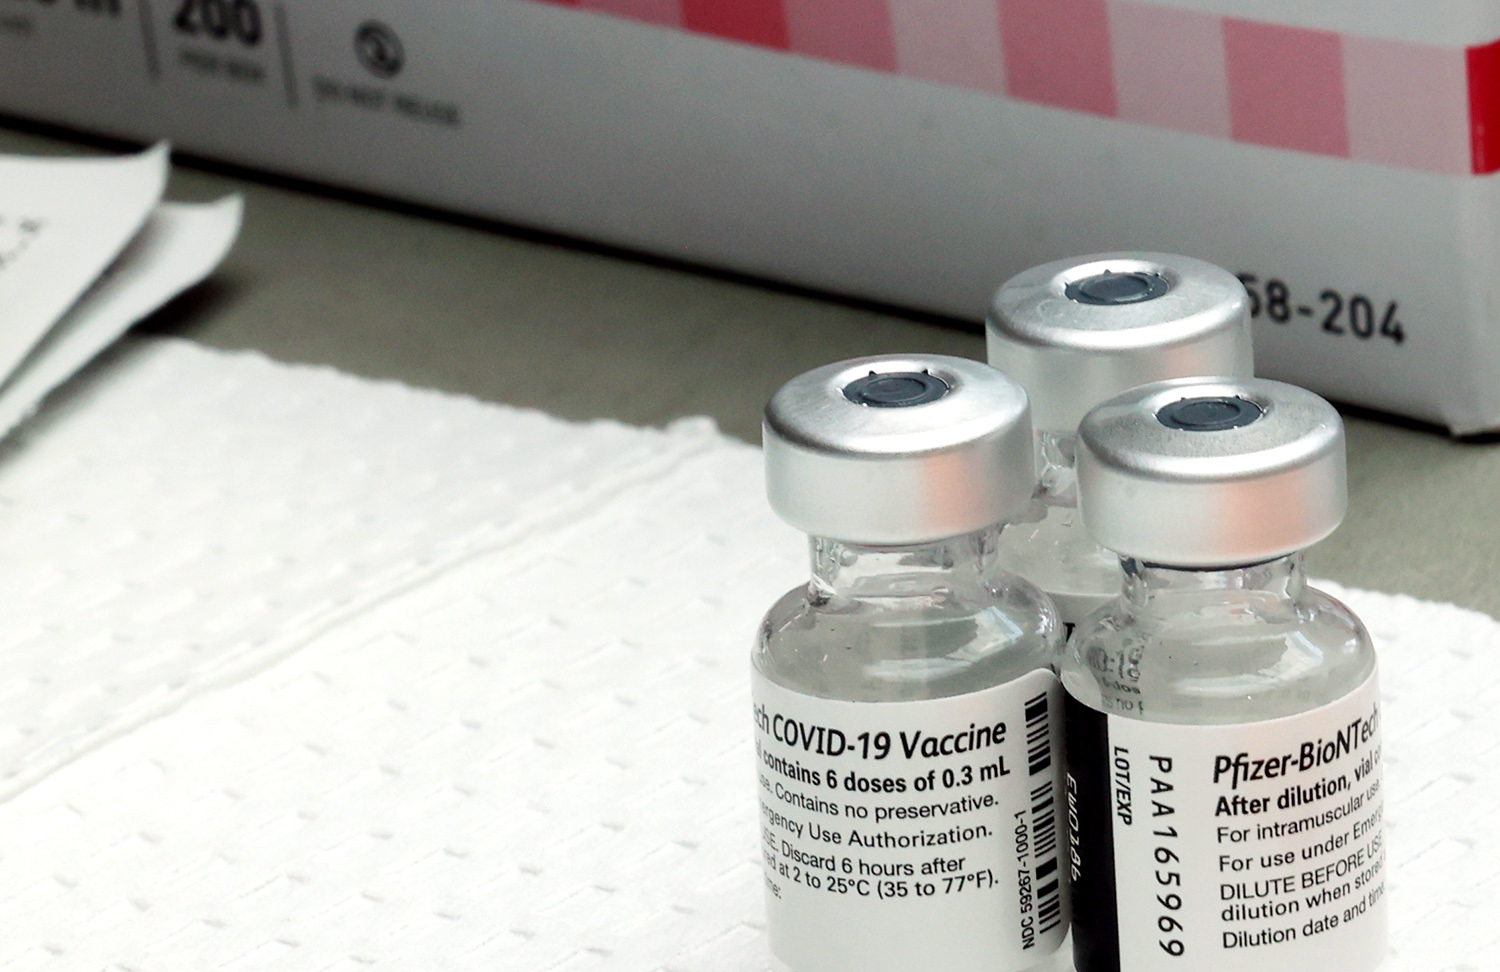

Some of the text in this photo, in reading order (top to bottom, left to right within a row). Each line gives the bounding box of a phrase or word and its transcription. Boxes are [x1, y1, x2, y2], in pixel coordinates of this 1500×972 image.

[773, 713, 892, 760] COVID-19
[899, 721, 1007, 760] Vaccine
[1213, 702, 1379, 790] Pfizer-BioNTech
[763, 749, 821, 786] contains
[826, 769, 838, 789] 6
[843, 771, 907, 793] doses
[914, 769, 936, 792] of
[942, 765, 973, 788] 0.3
[980, 755, 1011, 782] mL
[1114, 746, 1133, 826] LOT/EXP
[1214, 795, 1271, 817] After
[1277, 773, 1352, 810] dilution,
[1354, 750, 1373, 782] vial
[775, 782, 839, 816] Contains
[845, 803, 868, 819] no
[874, 794, 999, 823] preservative.
[1217, 826, 1251, 843] For
[1257, 793, 1364, 840] intramuscular
[781, 839, 836, 872] Discard
[842, 857, 853, 874] 6
[859, 858, 914, 876] hours
[920, 857, 966, 876] after
[809, 821, 842, 844] Use
[848, 825, 992, 848] Authorization.
[1149, 755, 1185, 957] PAA165969
[1219, 855, 1254, 872] For
[1260, 851, 1295, 869] use
[1302, 831, 1350, 860] under
[779, 862, 791, 879] at
[793, 866, 802, 883] 2
[805, 871, 821, 889] to
[877, 880, 909, 900] (35
[914, 881, 936, 897] to
[1014, 810, 1035, 950] NDC 59267-1000-1
[1220, 876, 1296, 901] DILUTE
[1301, 847, 1365, 889] BEFORE
[1221, 899, 1300, 922] dilution
[1305, 881, 1351, 909] when
[1222, 927, 1297, 949] Dilution
[1302, 914, 1339, 937] date
[1343, 895, 1367, 923] and
